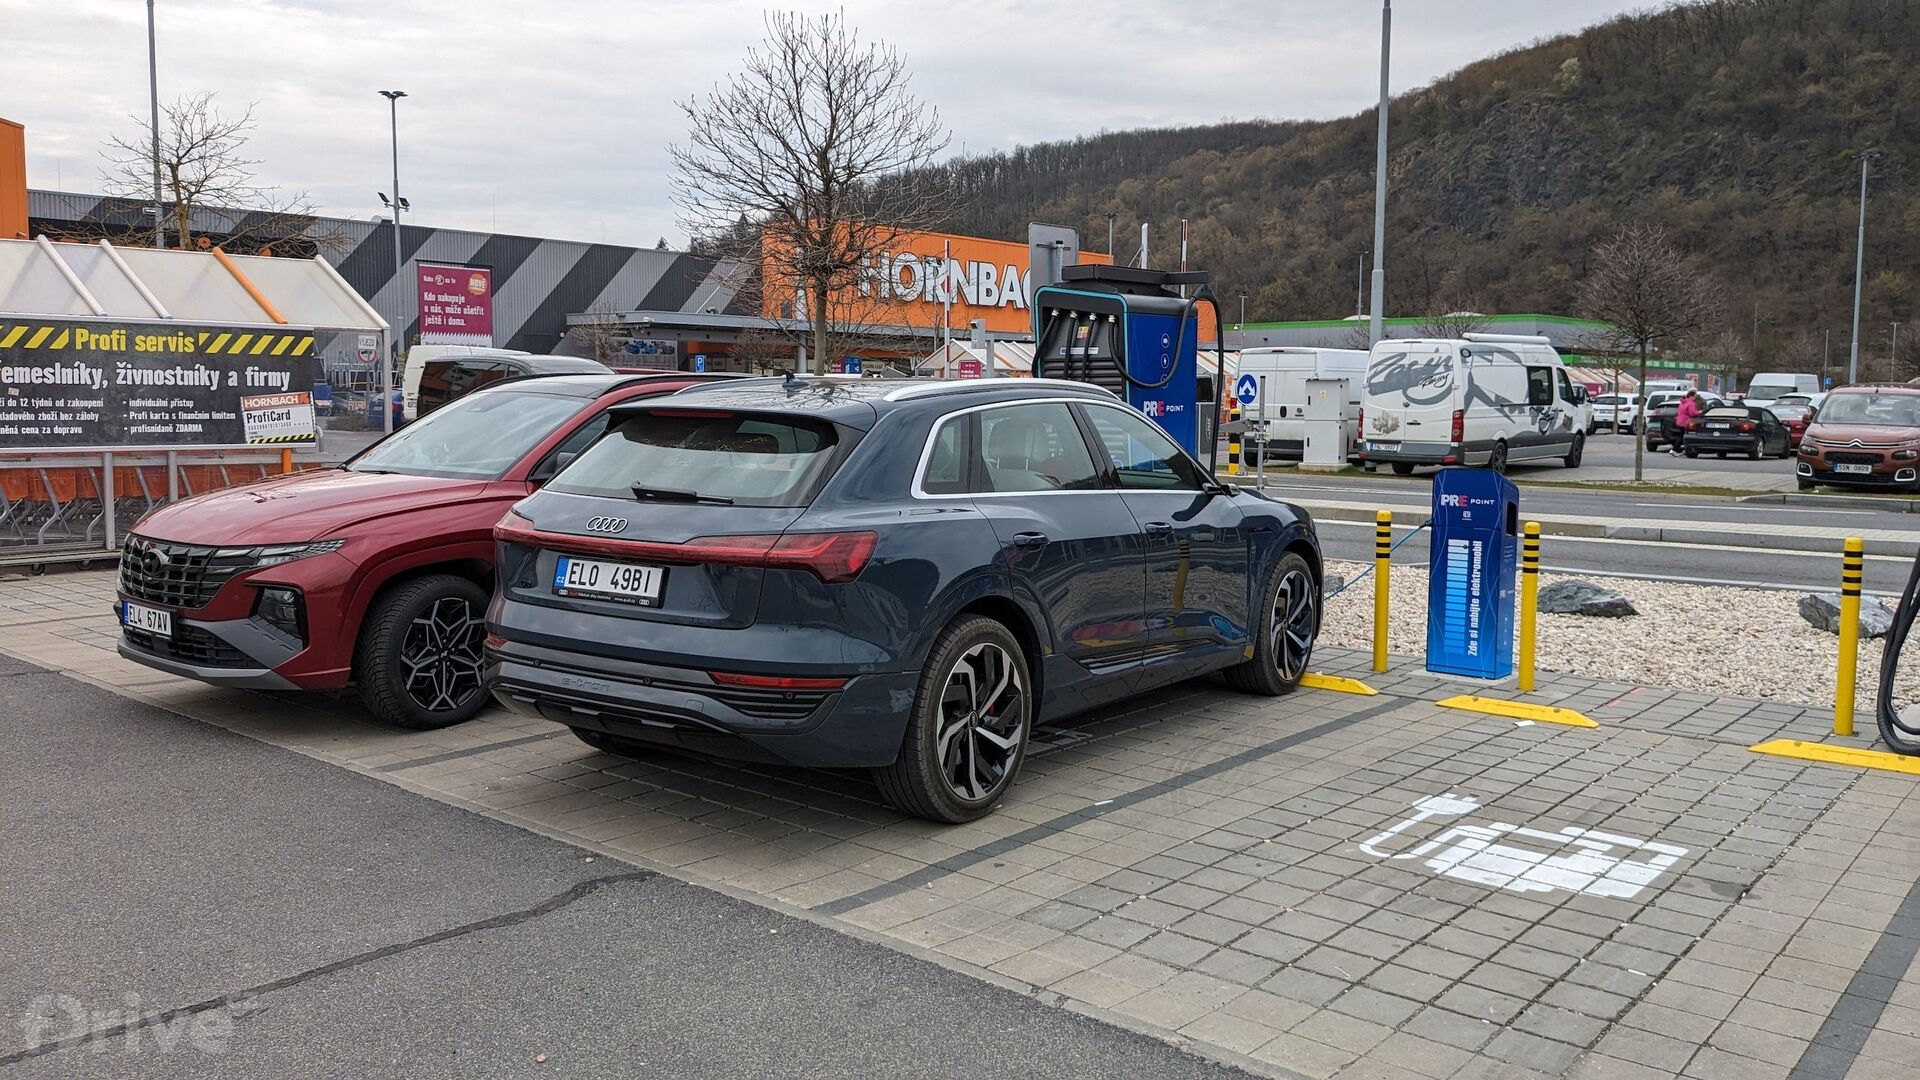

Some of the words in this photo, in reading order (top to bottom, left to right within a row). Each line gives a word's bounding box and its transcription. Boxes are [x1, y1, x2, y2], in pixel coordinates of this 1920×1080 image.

[424, 292, 435, 300] Kdo
[438, 293, 465, 304] nakupuje
[430, 305, 443, 314] nás,
[446, 305, 461, 314] může
[464, 305, 484, 315] ušetřit
[425, 315, 441, 325] ještě
[448, 317, 466, 325] doma.
[76, 328, 126, 351] Profi
[135, 332, 194, 353] servis
[0, 361, 108, 389] emeslníky,
[116, 362, 220, 390] živnostníky
[228, 370, 238, 386] a
[245, 366, 290, 391] firmy
[8, 398, 16, 406] do
[20, 398, 28, 406] 12
[32, 398, 52, 408] týdnů
[56, 398, 64, 406] od
[68, 398, 104, 408] zakoupení
[129, 398, 168, 407] individuální
[170, 398, 194, 408] přístup
[244, 396, 299, 408] HORNBACH
[1143, 401, 1164, 417] PRE
[38, 411, 57, 420] zboží
[60, 412, 72, 420] bez
[76, 412, 99, 422] zálohy
[130, 412, 147, 420] Profi
[150, 412, 169, 420] karta
[179, 411, 209, 420] finančním
[212, 412, 236, 420] limitem
[246, 410, 290, 424] ProfiCard
[54, 426, 82, 435] dopravu
[130, 423, 173, 434] profisnídaně
[176, 424, 202, 432] ZDARMA
[1441, 494, 1468, 506] PRE
[1471, 541, 1482, 596] elektromobil
[129, 606, 142, 625] EL4
[148, 611, 167, 631] 67AV
[1469, 598, 1480, 628] nabijte
[1469, 630, 1478, 638] si
[1468, 641, 1478, 656] Zde
[562, 678, 610, 692] e-tron
